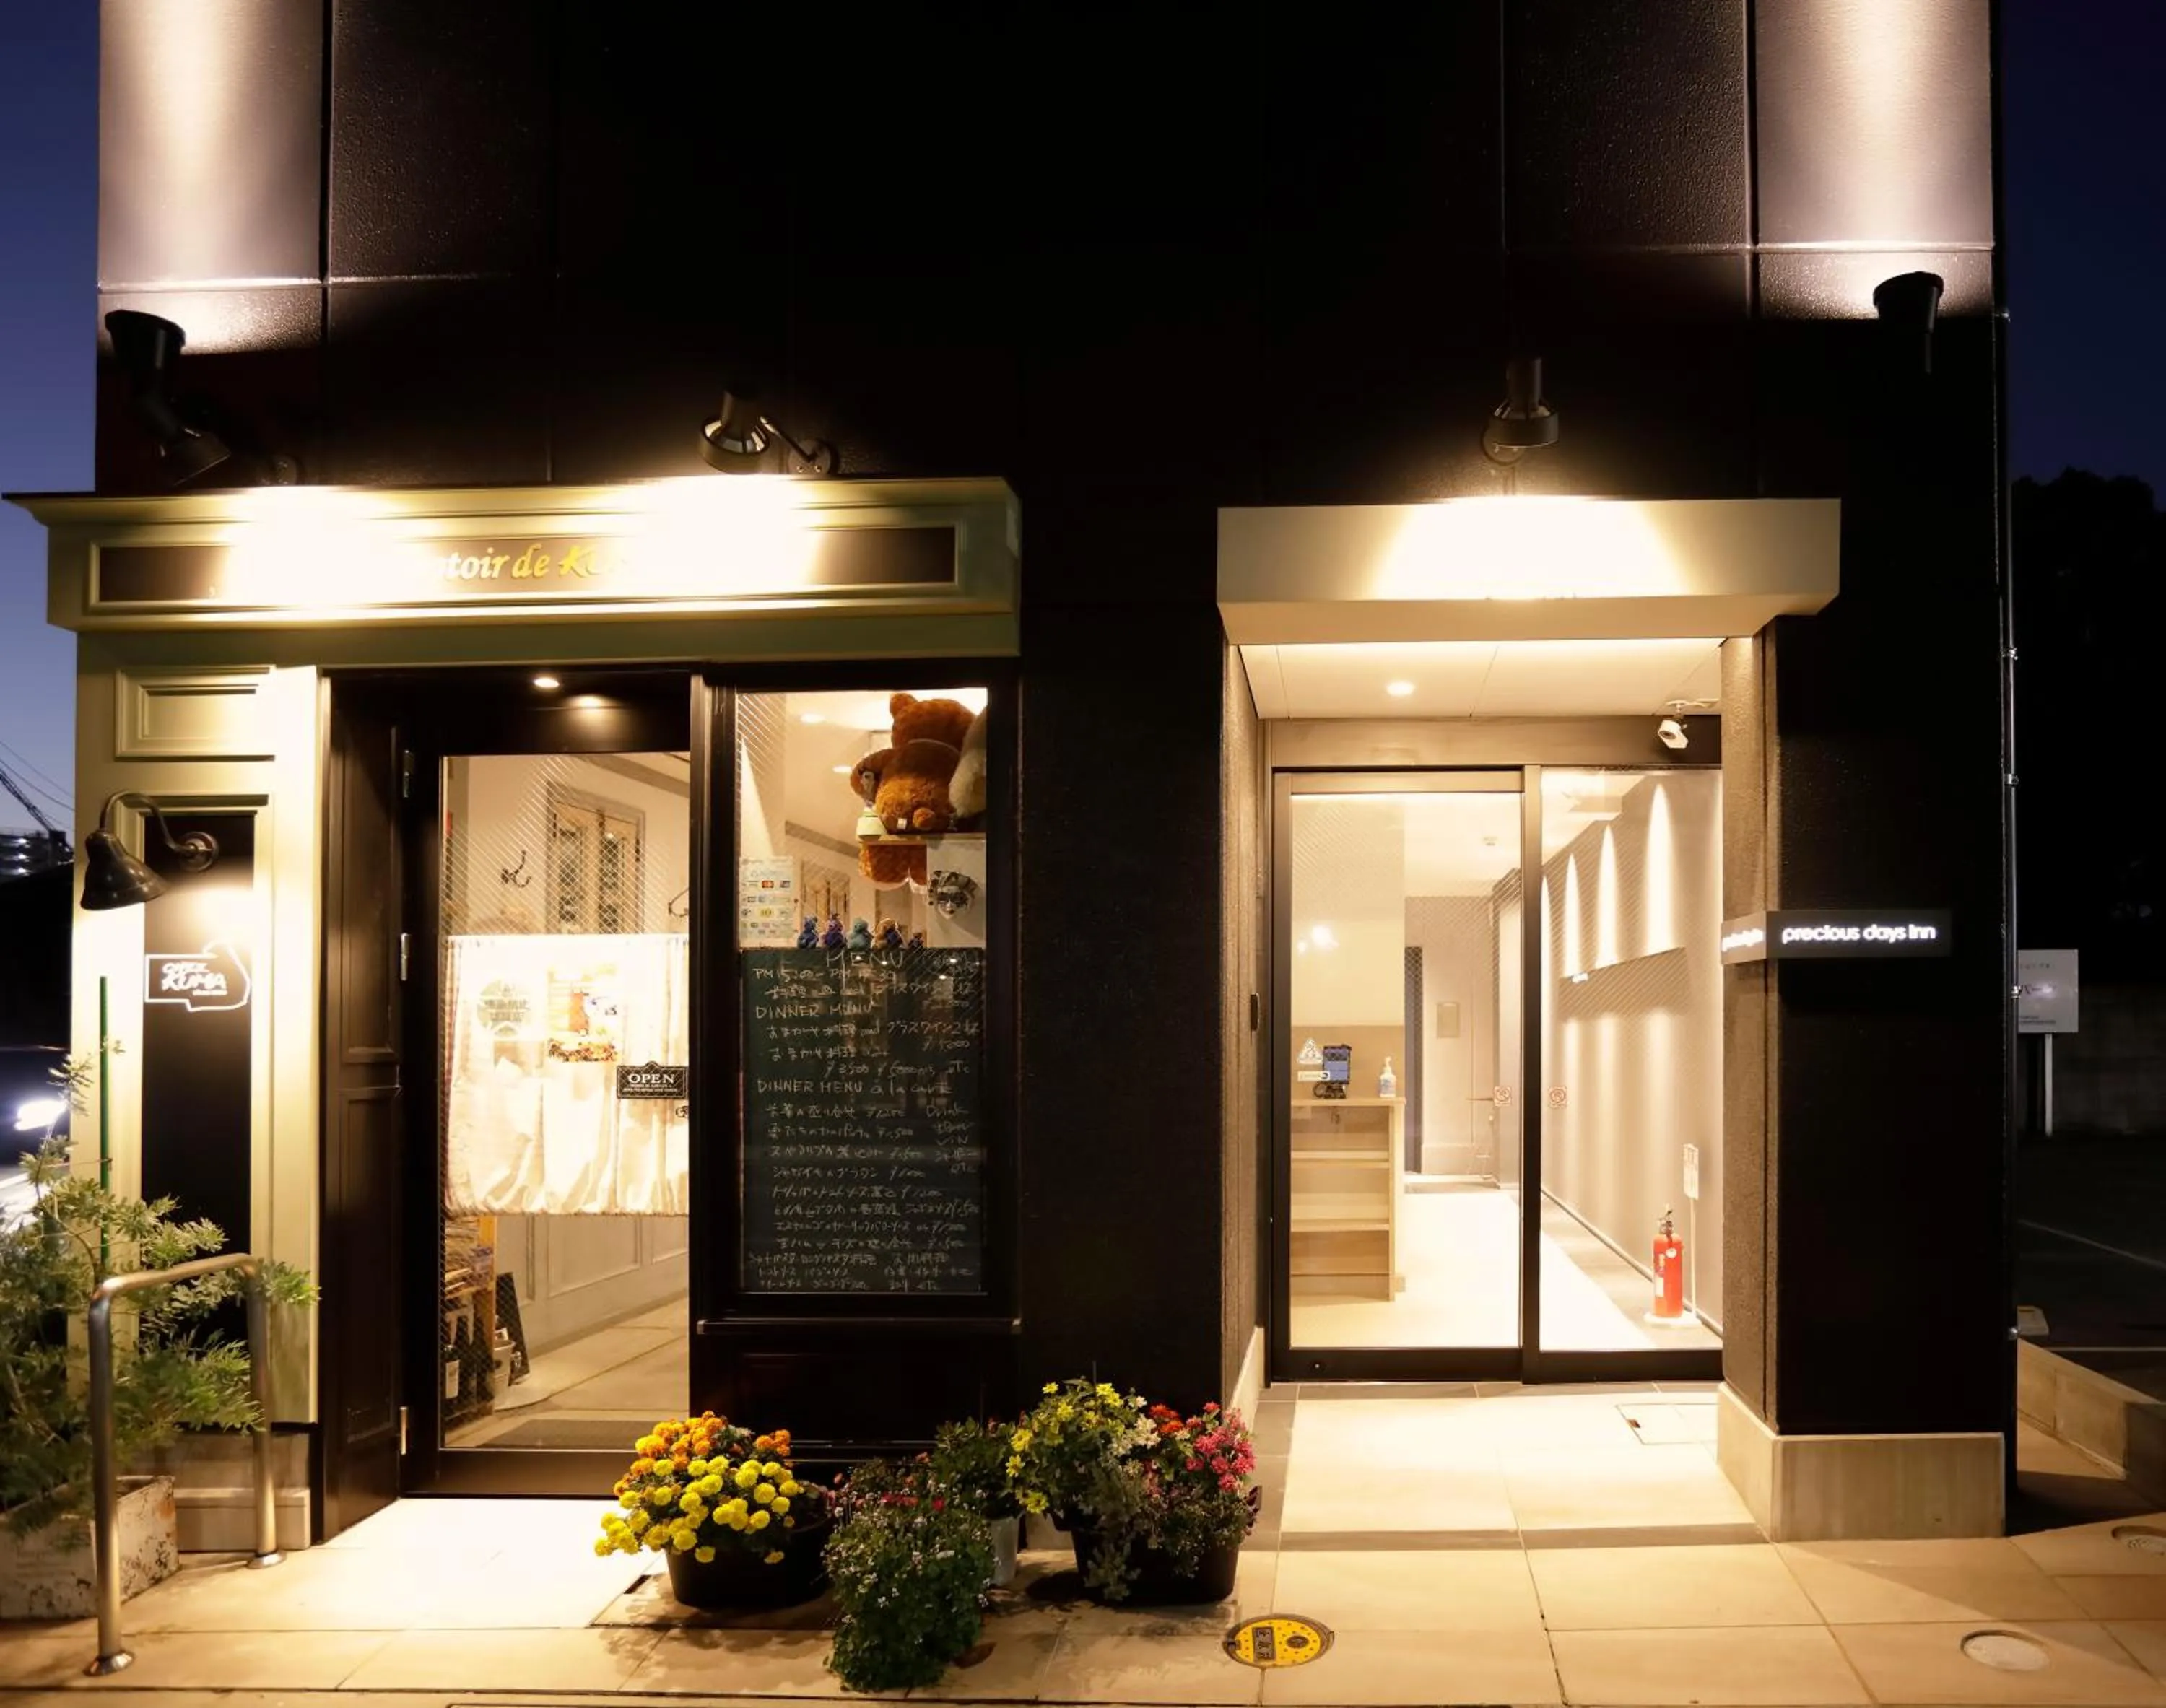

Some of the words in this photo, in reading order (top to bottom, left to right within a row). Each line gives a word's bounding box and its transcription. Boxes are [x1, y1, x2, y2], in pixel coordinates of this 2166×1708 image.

[511, 544, 550, 578] de
[1781, 925, 1861, 944] precious
[1863, 923, 1907, 943] days
[756, 1004, 820, 1019] DINNER
[627, 1073, 675, 1084] OPEN
[757, 1079, 814, 1094] DINNER
